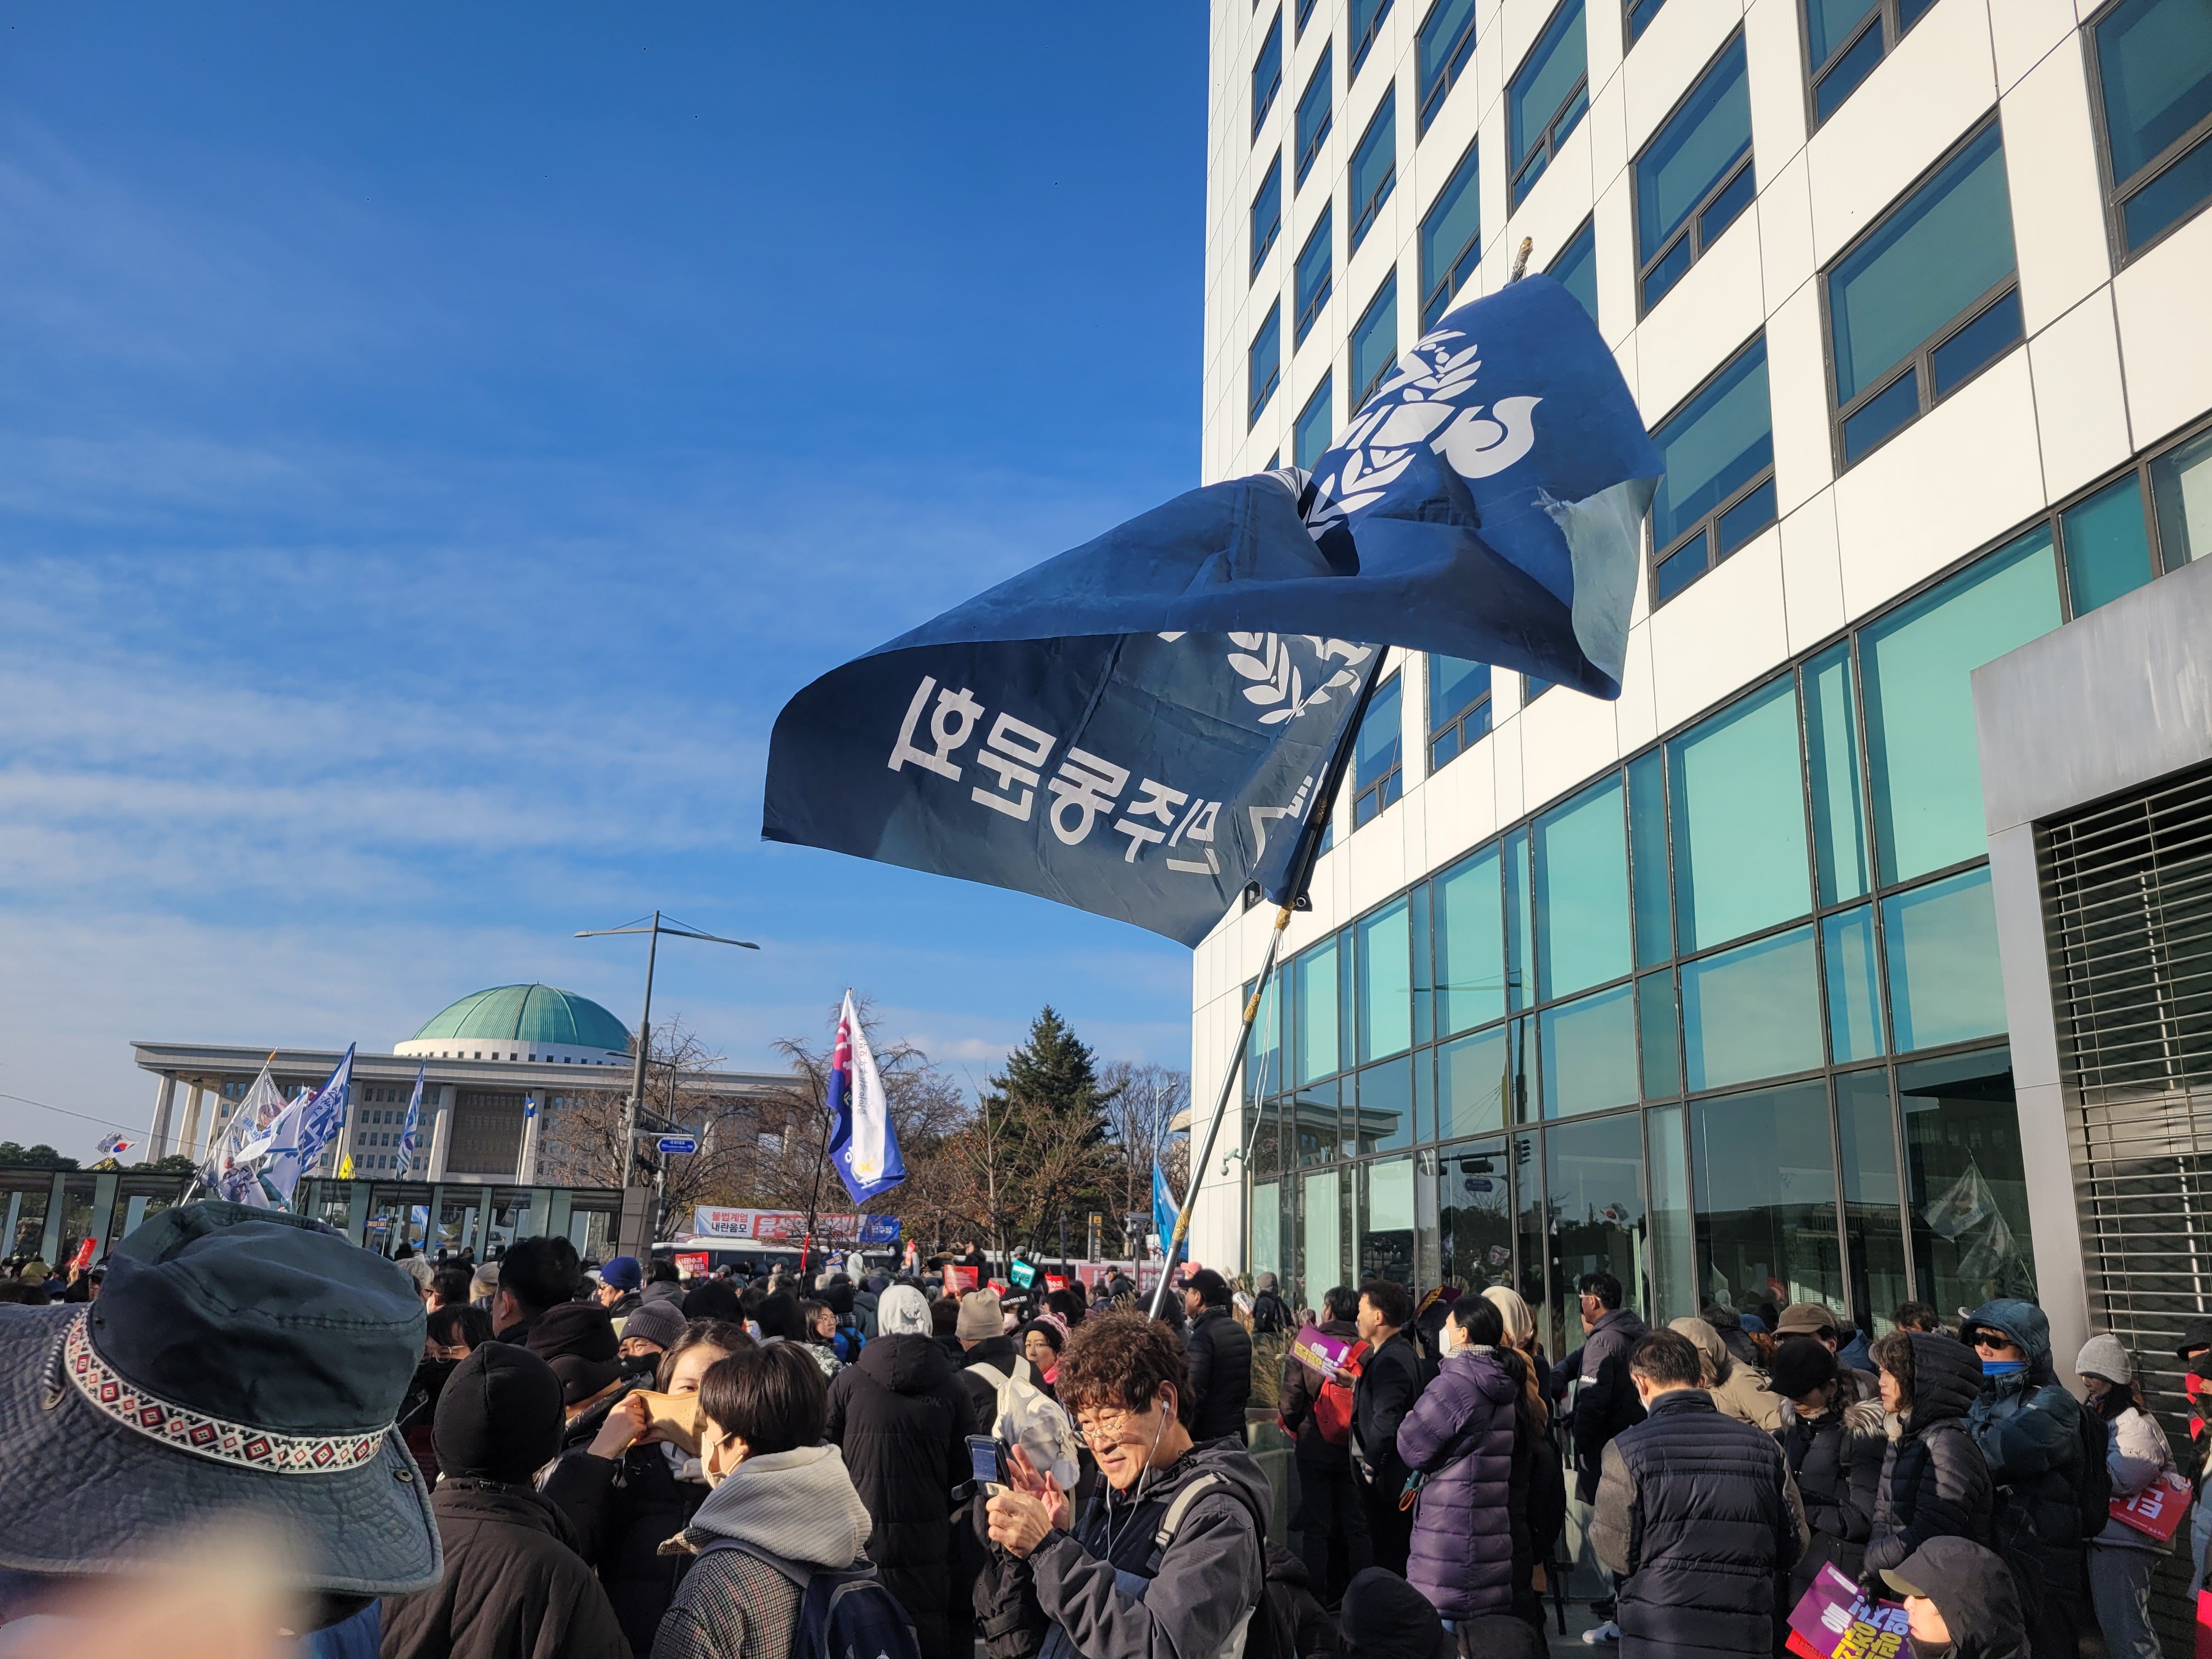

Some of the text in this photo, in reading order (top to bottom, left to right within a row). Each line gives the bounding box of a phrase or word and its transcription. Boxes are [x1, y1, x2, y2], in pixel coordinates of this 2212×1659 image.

[712, 1211, 748, 1223] 불법계엄
[711, 1222, 748, 1233] 내란음모
[1097, 1229, 1101, 1237] 1
[1848, 1595, 1909, 1635] 열자!
